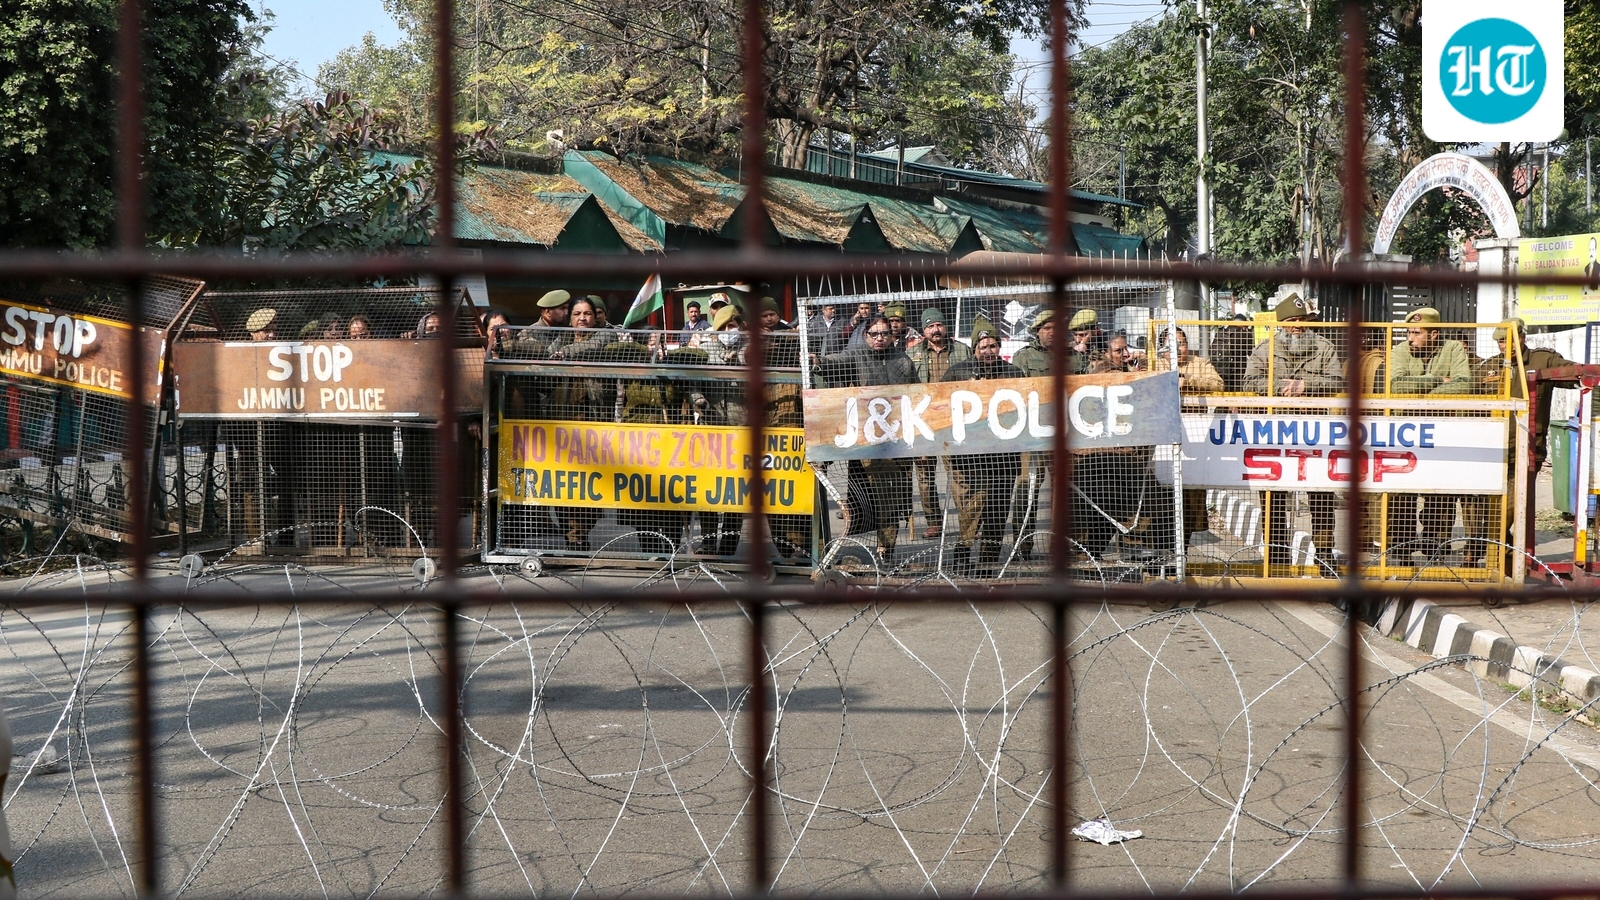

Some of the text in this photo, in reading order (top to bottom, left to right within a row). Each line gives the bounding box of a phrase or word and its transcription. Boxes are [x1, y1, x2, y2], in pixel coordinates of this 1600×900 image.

[1390, 186, 1405, 218] अमर
[1403, 173, 1418, 194] नाथ
[1530, 240, 1574, 253] WELCOME
[1535, 259, 1561, 270] BALIDAN
[1561, 257, 1580, 267] DIVAS
[1, 306, 97, 359] STOP
[54, 357, 123, 392] POLICE
[266, 344, 354, 382] STOP
[237, 386, 386, 411] JAMMU POLICE
[834, 385, 1135, 449] J&K POLCE
[1209, 419, 1321, 446] JAMMU
[511, 425, 738, 471] NO PARKING ZONE
[1241, 448, 1419, 483] STOP
[511, 467, 795, 507] TRAFFIC POLICE JAMMU
